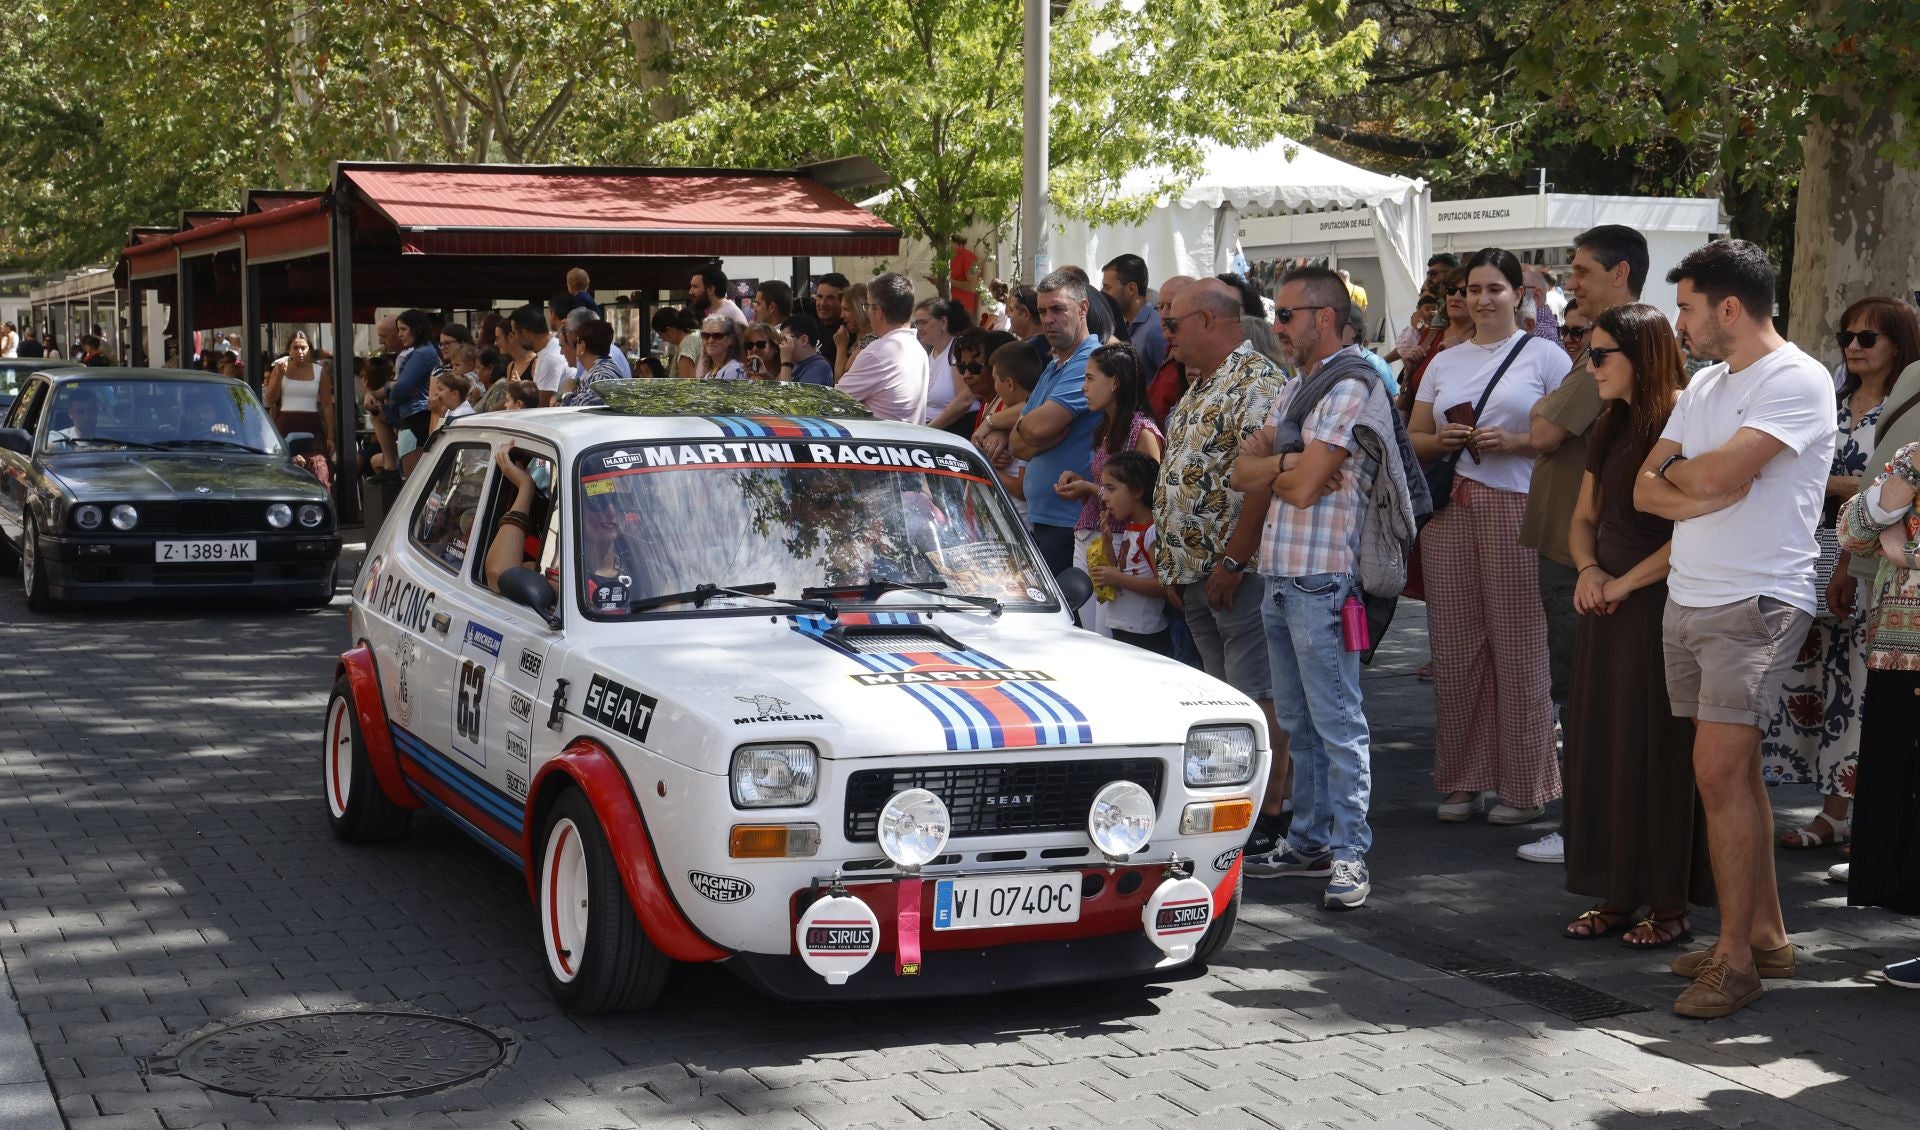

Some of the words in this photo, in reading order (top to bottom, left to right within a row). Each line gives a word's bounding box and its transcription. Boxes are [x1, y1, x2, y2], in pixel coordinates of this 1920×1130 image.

[1438, 210, 1471, 221] DIPUTACIÓN
[1473, 210, 1481, 220] DE
[1482, 208, 1510, 219] PALENCIA
[1350, 219, 1358, 229] DE
[605, 455, 641, 466] MARTINI
[643, 442, 794, 467] MARTINI
[808, 443, 936, 469] RACING
[937, 458, 968, 470] MARTINI
[1028, 588, 1045, 600] 032
[380, 574, 436, 633] RACING
[473, 630, 501, 650] MICHELIN
[519, 650, 542, 676] WEBER
[859, 670, 1050, 685] MARTINI
[456, 659, 487, 745] 63
[586, 683, 652, 730] SEAT
[733, 714, 824, 725] MICHELIN
[986, 794, 1034, 805] SEAT
[1256, 838, 1270, 846] BOSS
[693, 873, 747, 892] MAGNETI
[954, 889, 979, 919] VI
[939, 909, 949, 920] E
[1173, 906, 1207, 923] SIRIUS
[829, 930, 870, 944] SIRIUS
[902, 965, 918, 974] OMP
